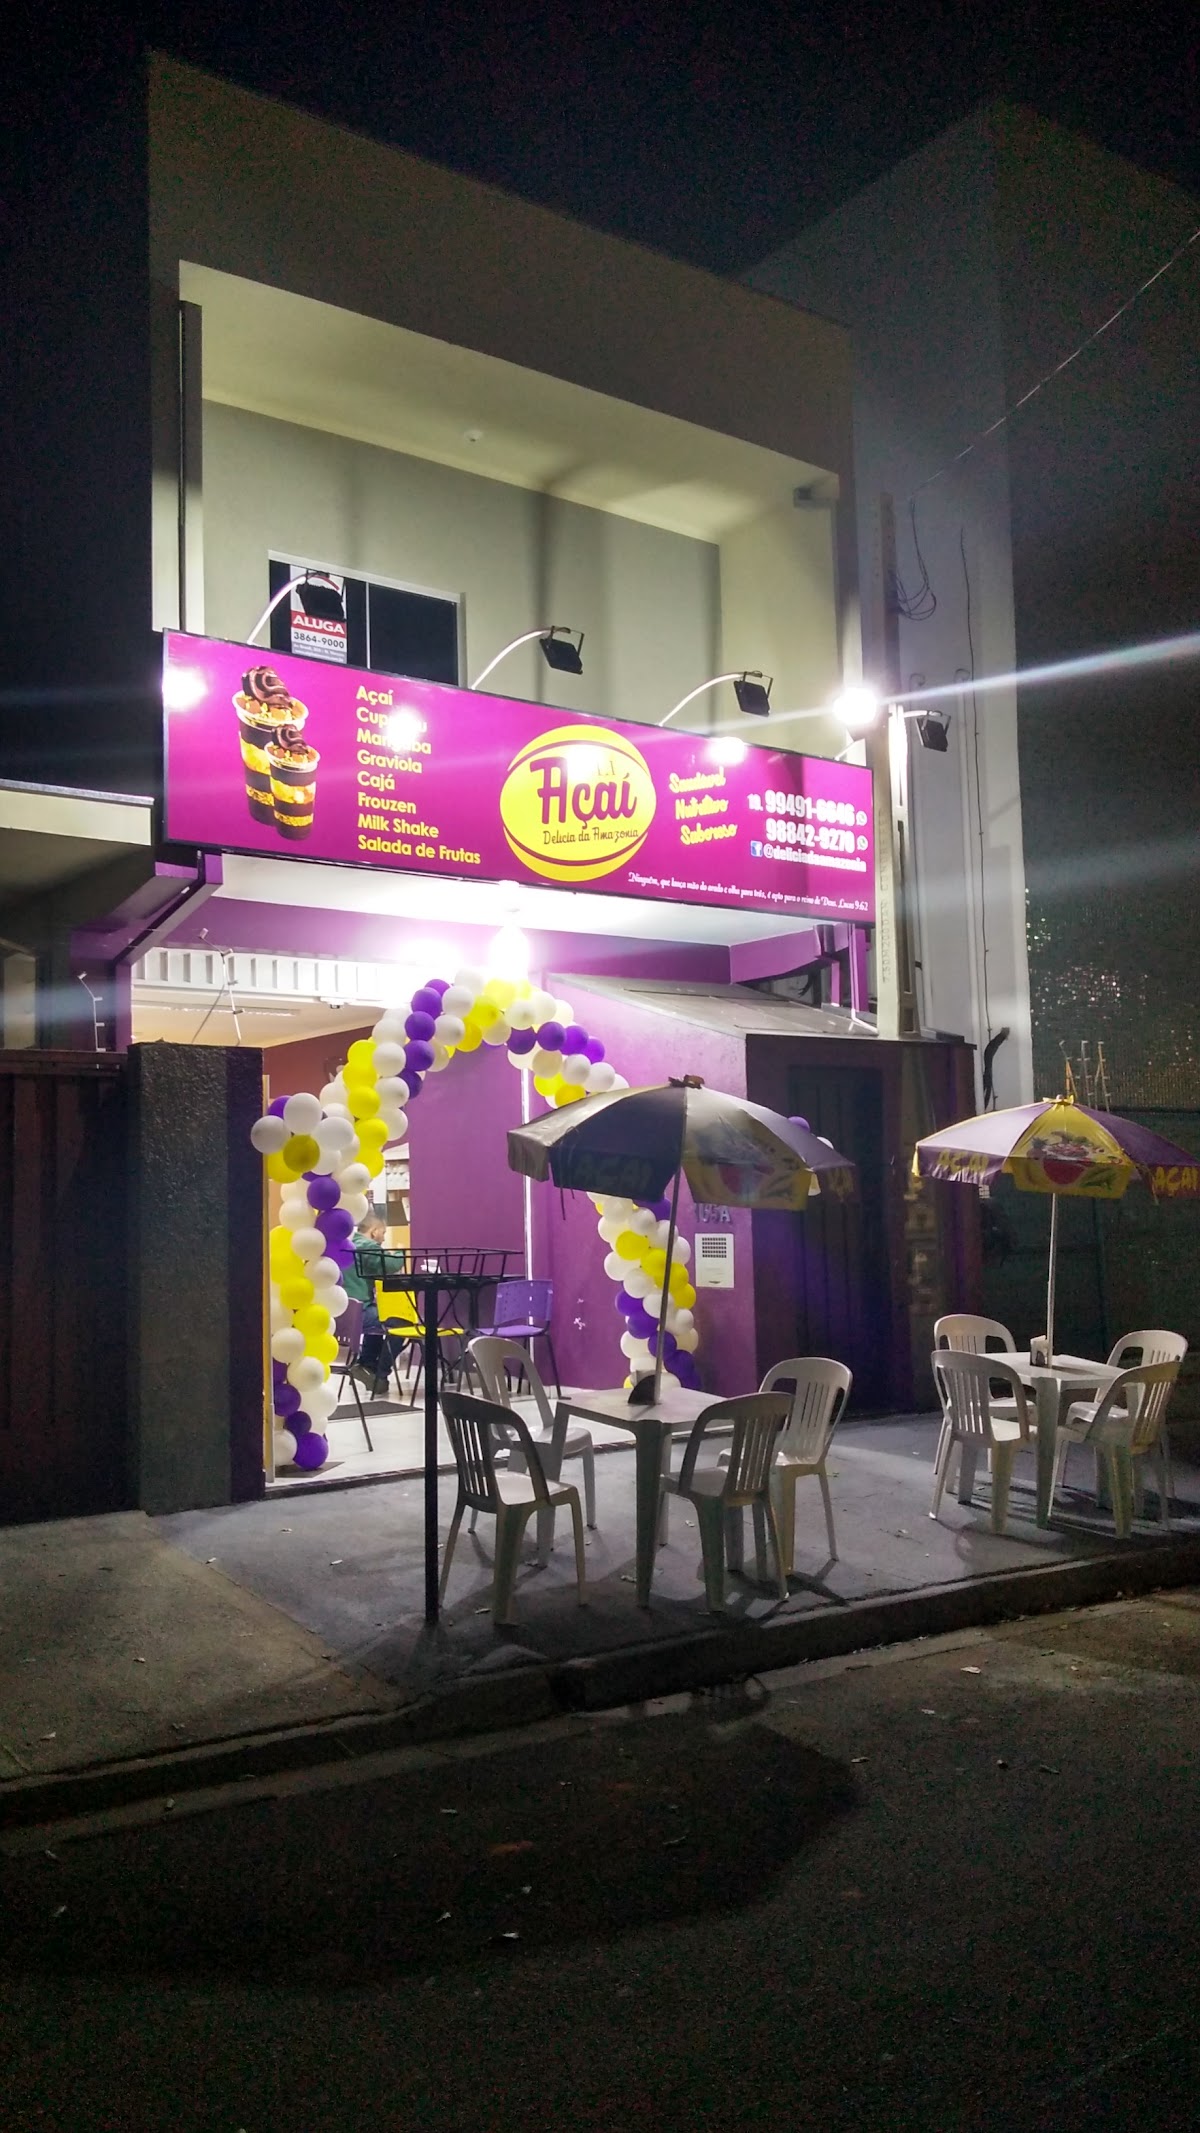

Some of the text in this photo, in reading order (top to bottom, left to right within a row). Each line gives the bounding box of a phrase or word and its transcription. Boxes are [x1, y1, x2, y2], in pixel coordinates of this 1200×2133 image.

[293, 615, 345, 634] ALUGA
[293, 632, 344, 649] 3864-9000
[356, 686, 393, 706] Açaí
[357, 749, 423, 774] Graviola
[357, 770, 395, 792] Cajá
[358, 792, 417, 814] Frouzen
[529, 756, 638, 830] Açaí
[358, 813, 439, 838] Milk Shake
[578, 829, 590, 842] da
[765, 817, 856, 854] 98842-9270
[358, 834, 481, 864] Salada de Frutas
[699, 881, 708, 892] do
